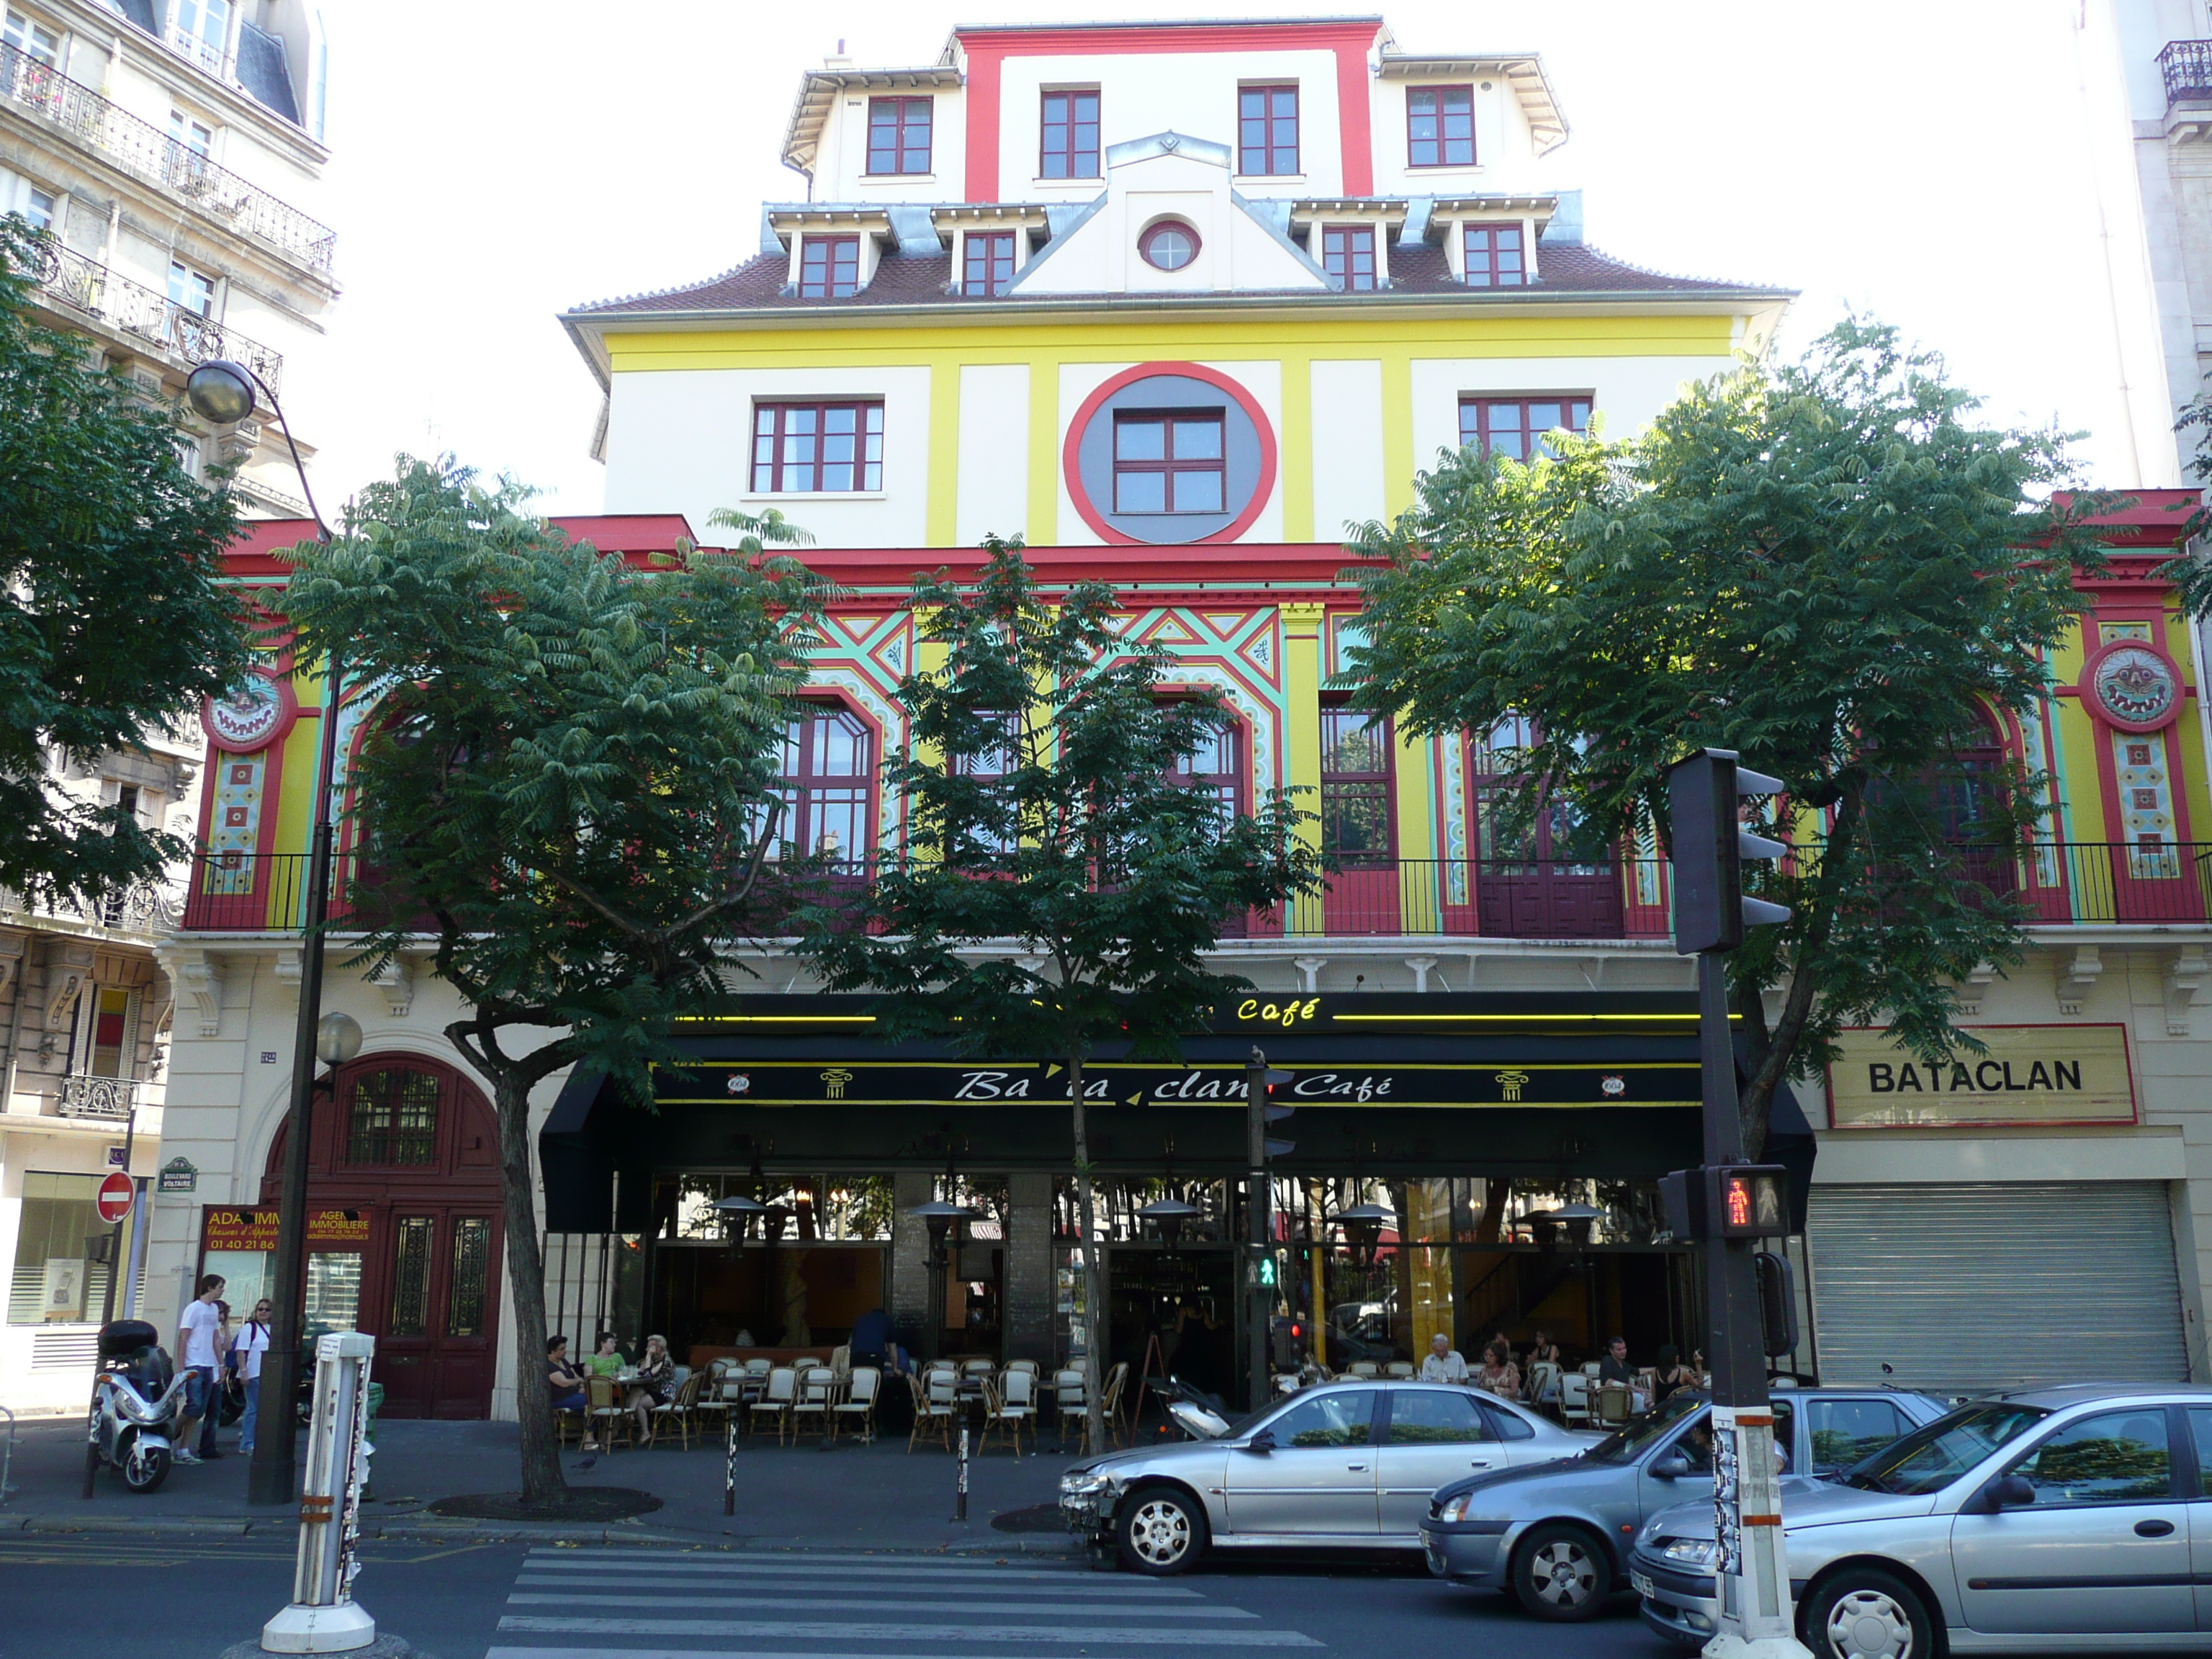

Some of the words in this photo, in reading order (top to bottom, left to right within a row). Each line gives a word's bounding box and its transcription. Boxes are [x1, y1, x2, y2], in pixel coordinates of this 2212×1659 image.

[1238, 997, 1321, 1027] Café
[1869, 1059, 2082, 1092] BATACLAN
[1295, 1073, 1393, 1102] Café
[209, 1213, 245, 1225] ADA
[320, 1211, 349, 1220] AGEN
[310, 1220, 369, 1229] IMMOBILIERE
[211, 1240, 222, 1249] 01
[226, 1240, 241, 1249] 40
[245, 1240, 256, 1249] 21
[260, 1241, 275, 1249] 86
